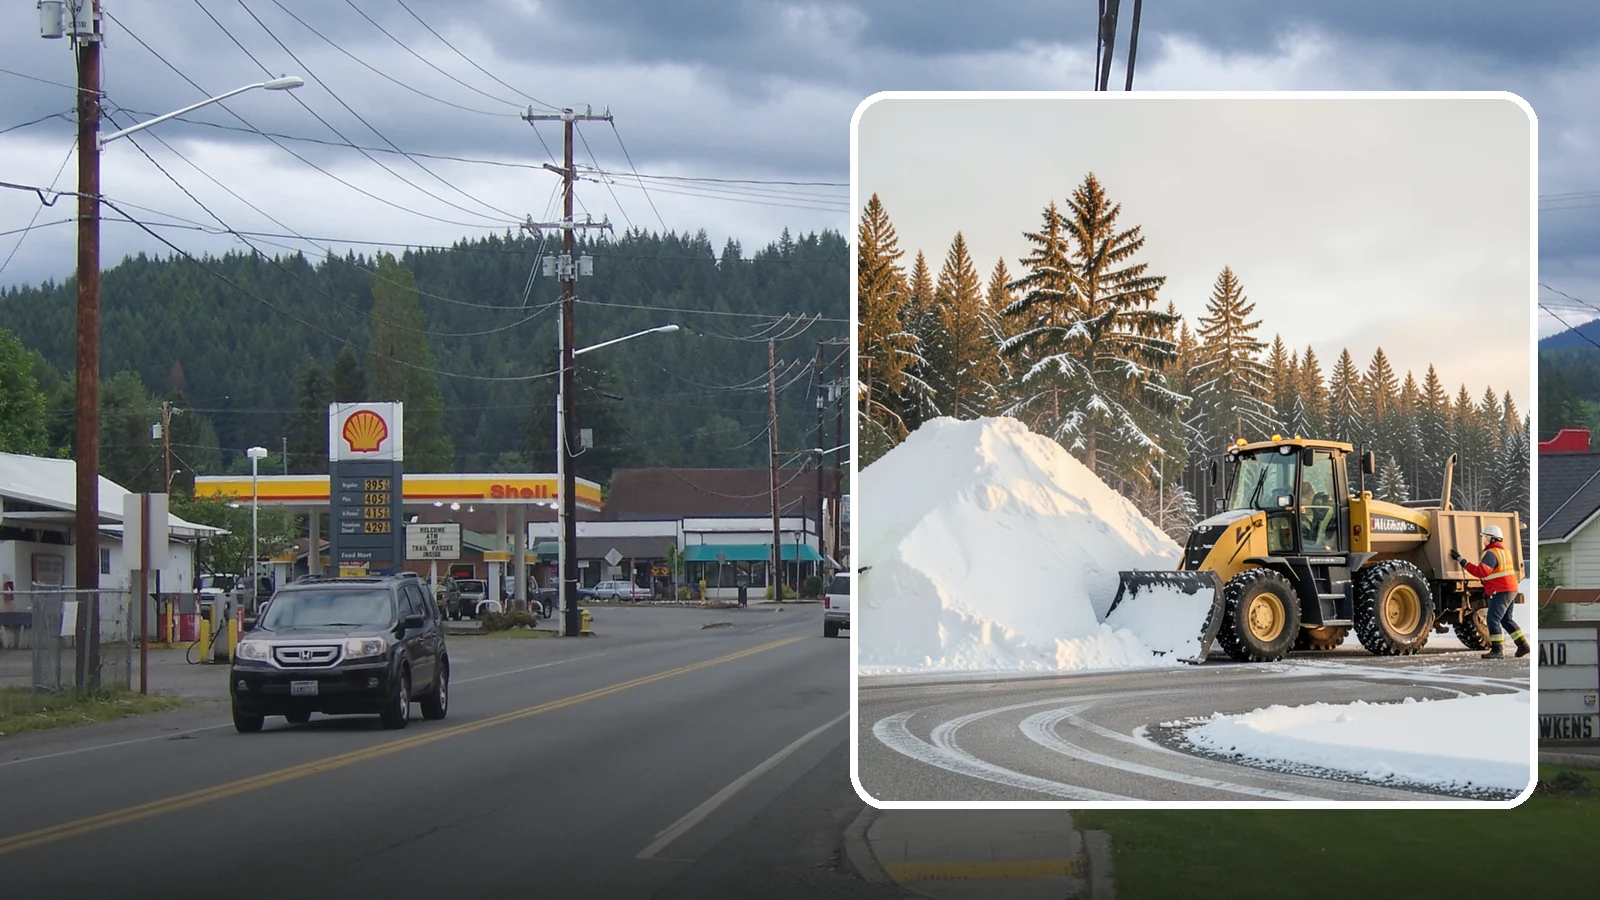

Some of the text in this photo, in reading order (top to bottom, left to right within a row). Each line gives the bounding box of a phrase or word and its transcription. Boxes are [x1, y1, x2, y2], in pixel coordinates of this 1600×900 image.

[366, 480, 383, 490] 395
[490, 484, 547, 499] Shell
[366, 494, 383, 504] 405
[366, 508, 383, 518] 415
[366, 522, 383, 532] 429
